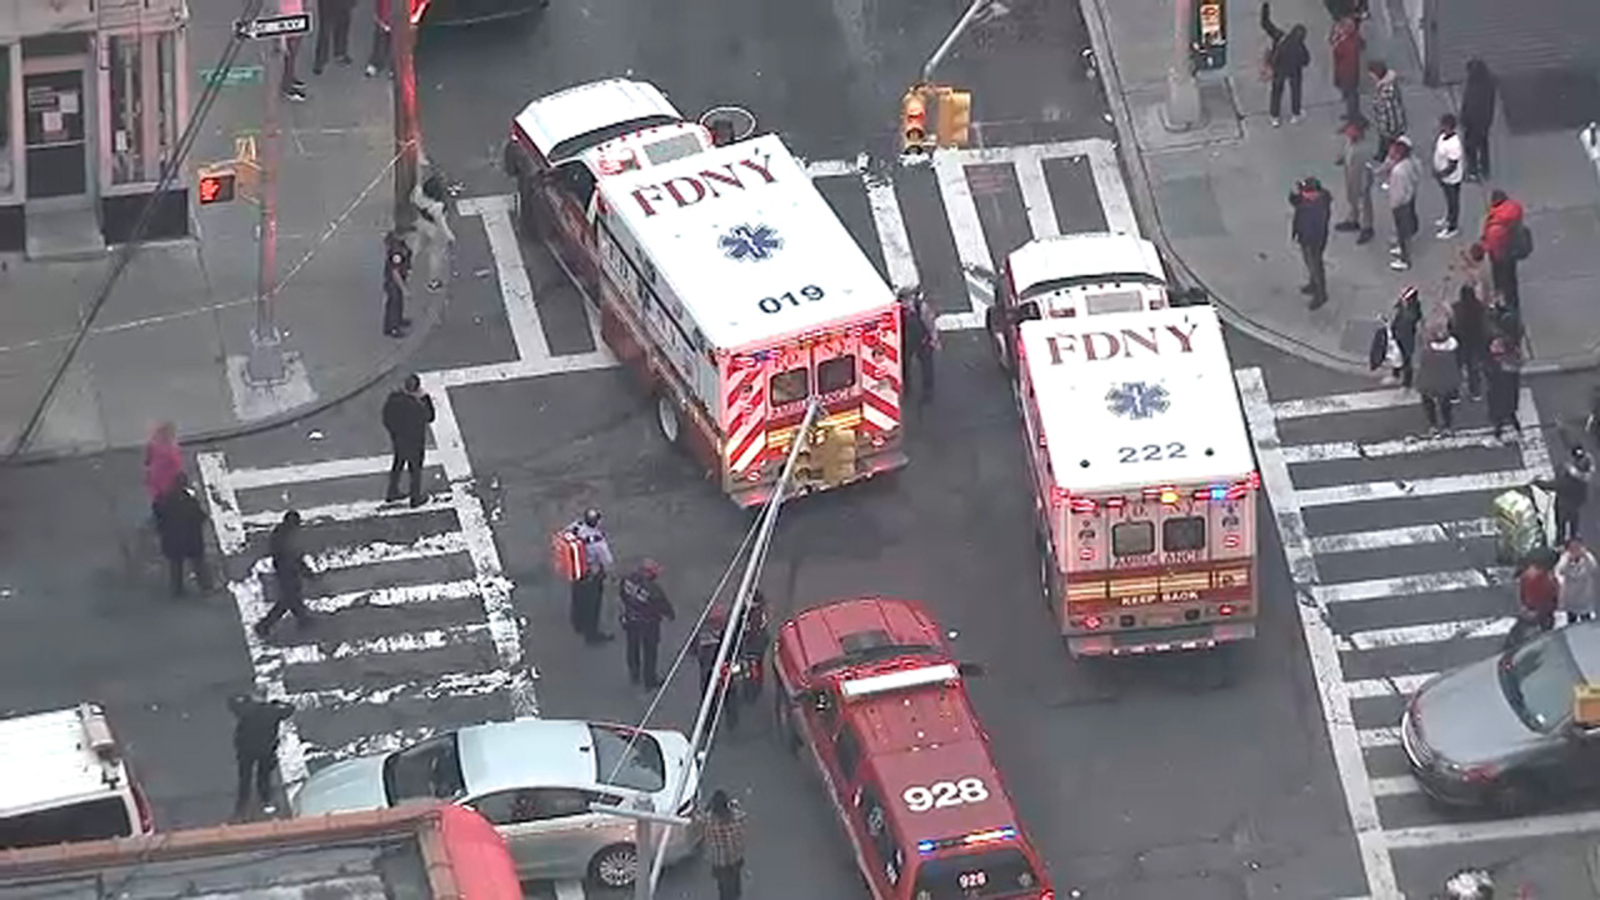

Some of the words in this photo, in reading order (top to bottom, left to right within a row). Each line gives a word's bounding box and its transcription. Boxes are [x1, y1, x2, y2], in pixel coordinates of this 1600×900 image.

[631, 153, 777, 217] FDNY
[758, 284, 826, 314] 019
[1046, 323, 1198, 365] FDNY
[1117, 441, 1189, 464] 222
[1121, 594, 1156, 606] KEEP
[1161, 591, 1199, 602] BACK
[902, 776, 990, 813] 928
[958, 871, 987, 889] 928
